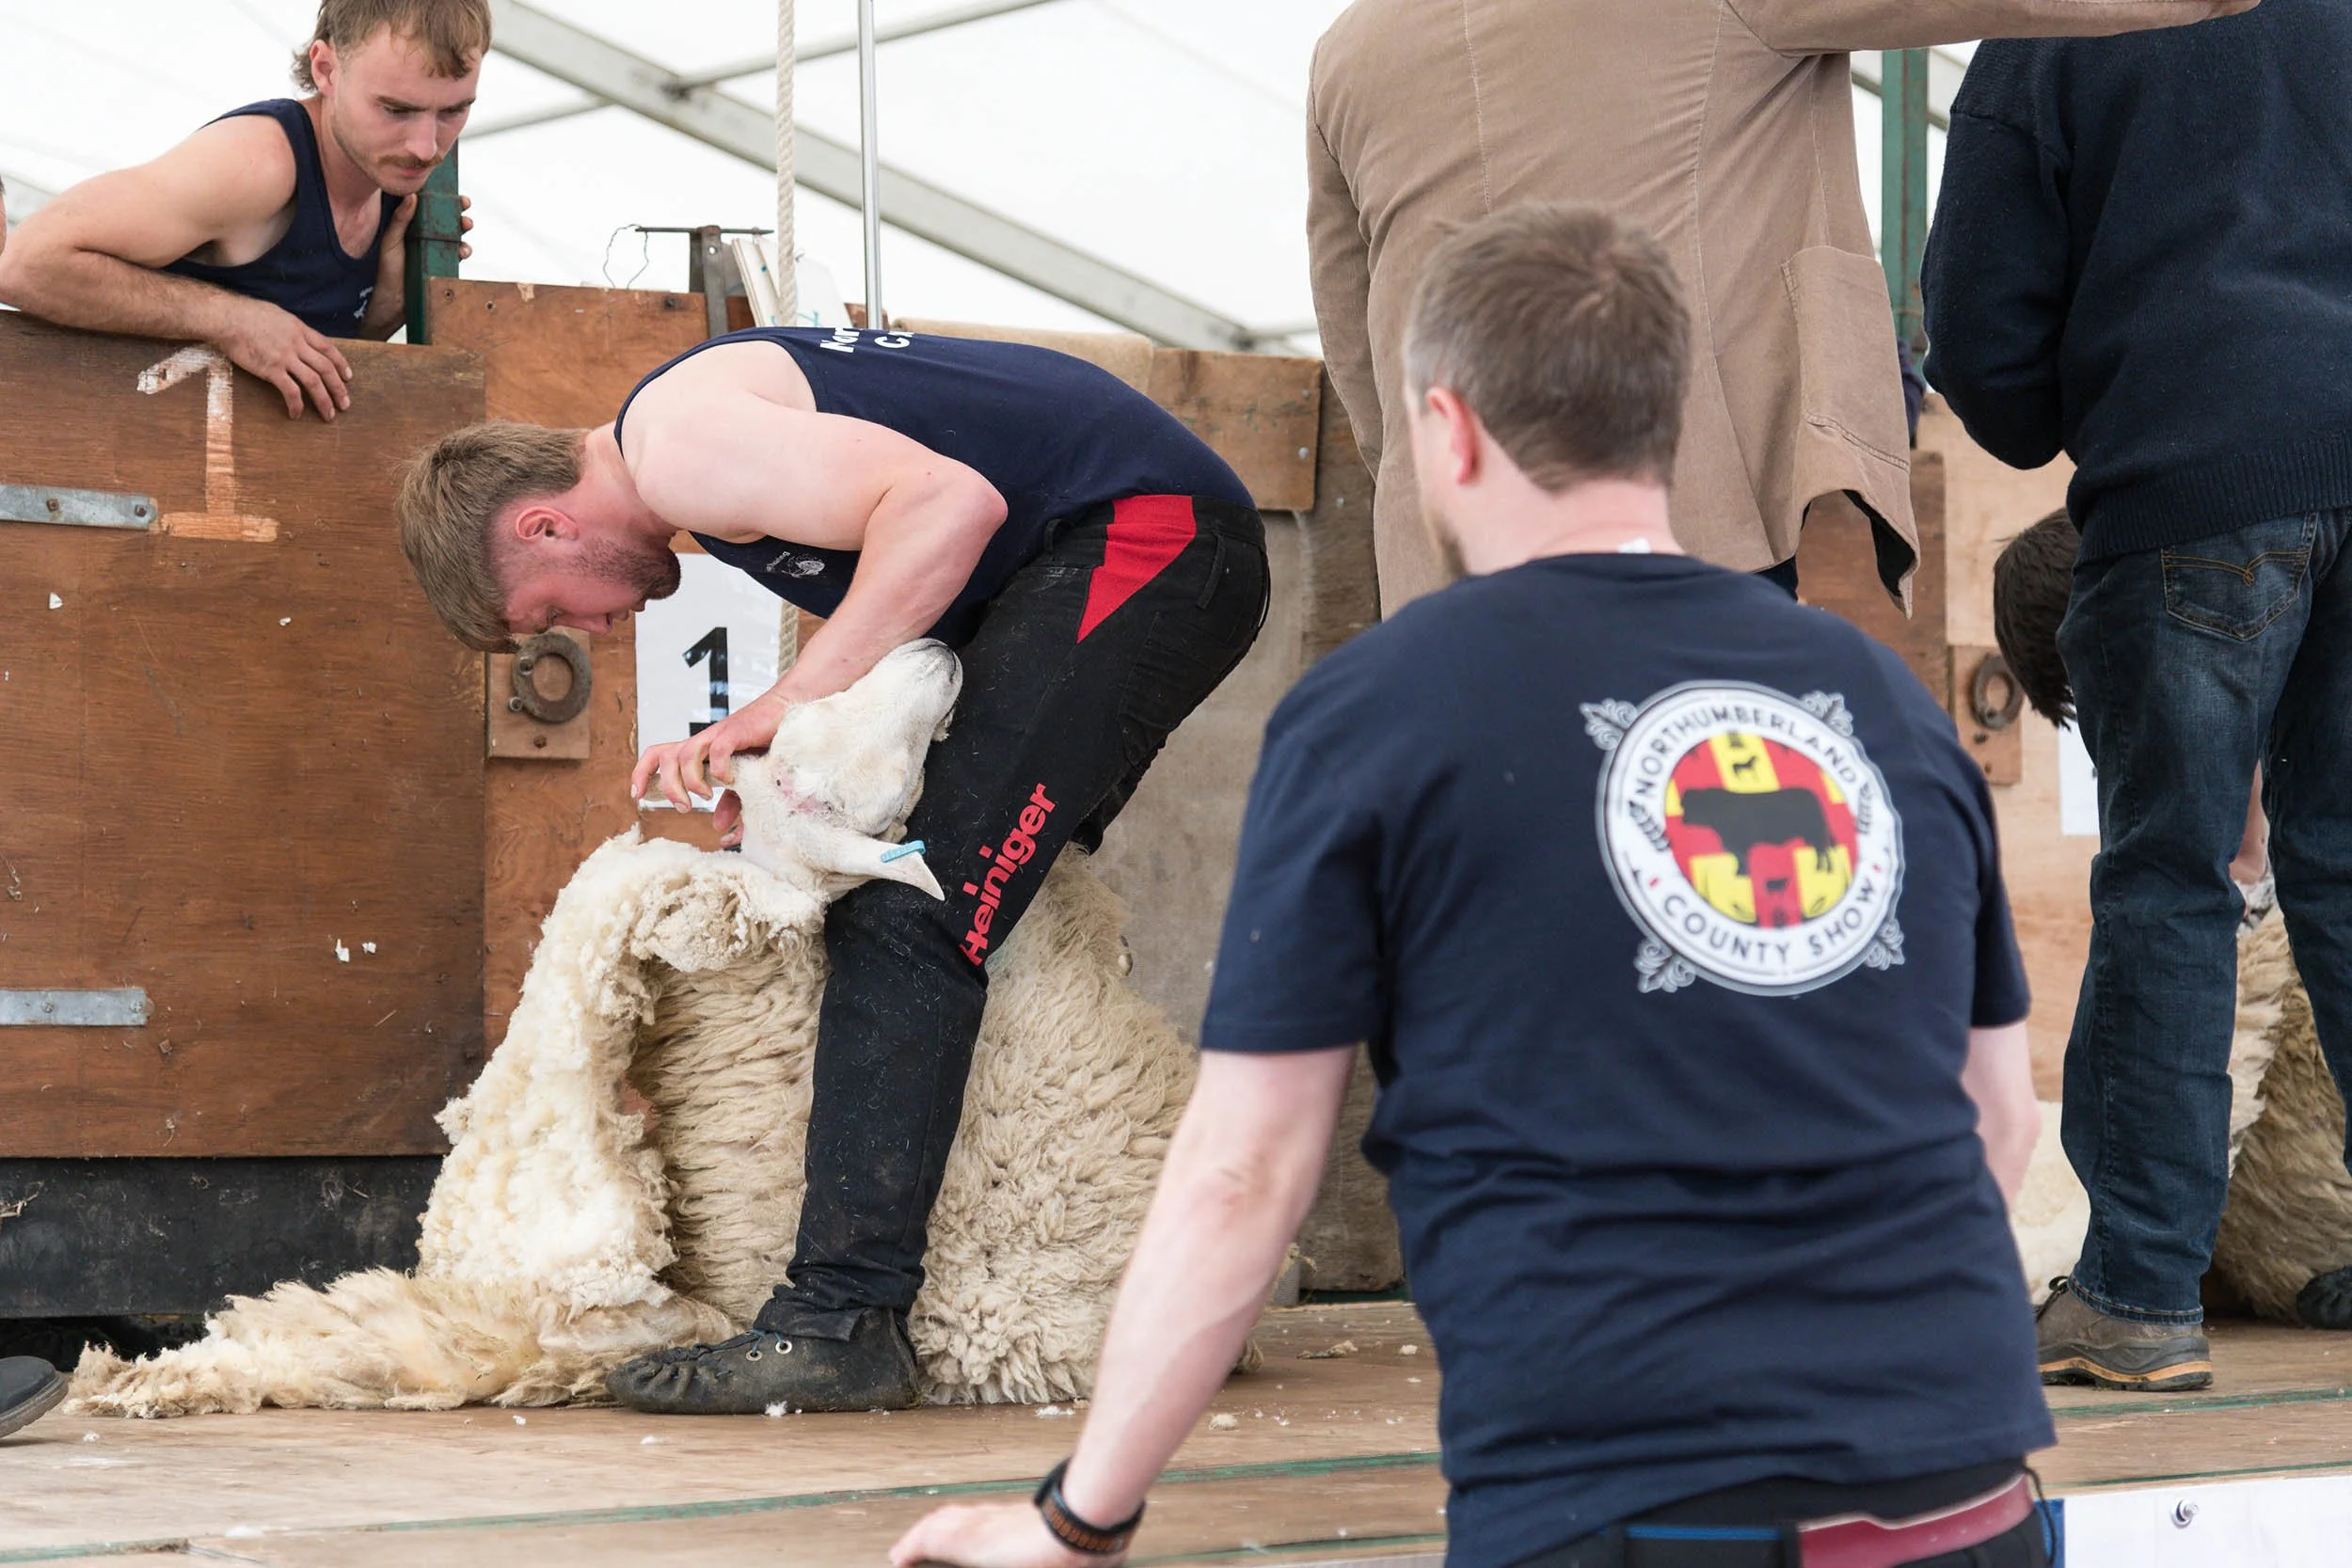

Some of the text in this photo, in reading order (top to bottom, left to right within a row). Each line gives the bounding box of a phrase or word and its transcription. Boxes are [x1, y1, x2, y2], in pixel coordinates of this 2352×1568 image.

[136, 344, 280, 543] 1
[682, 626, 729, 738] 1
[1634, 705, 1857, 796] NORTHUMBERLAND
[959, 783, 1057, 967] Heiniger
[1663, 878, 1876, 964] COUNTY SHOW
